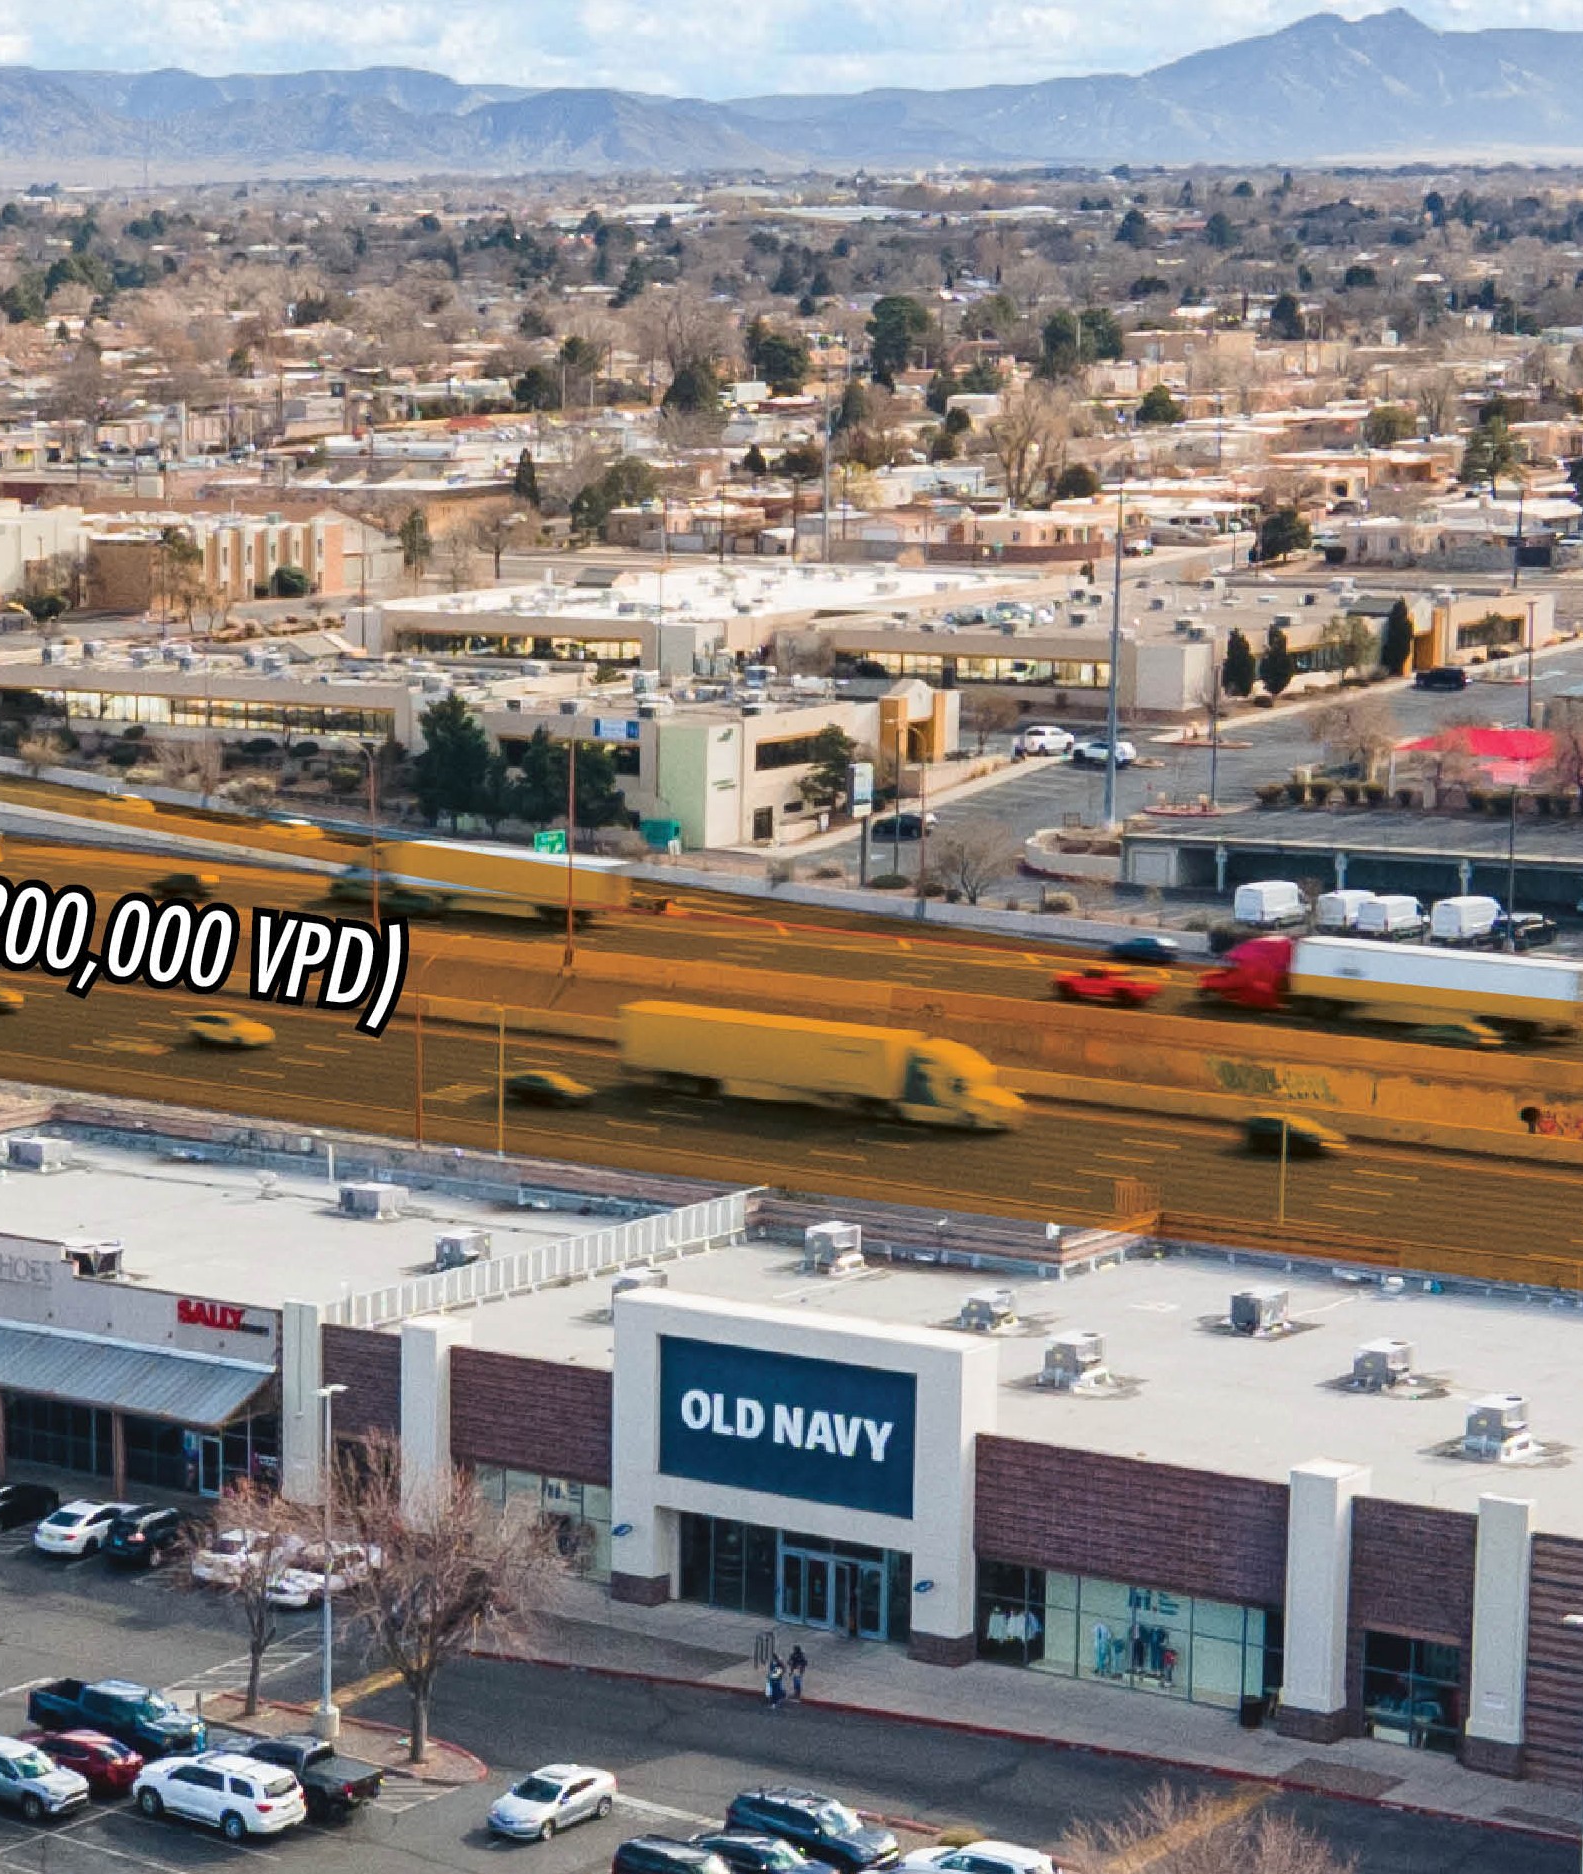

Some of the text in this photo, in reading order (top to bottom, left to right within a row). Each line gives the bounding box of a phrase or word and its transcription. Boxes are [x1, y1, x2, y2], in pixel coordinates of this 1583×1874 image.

[177, 1298, 245, 1331] SALLY
[680, 1388, 895, 1462] OLD NAVY
